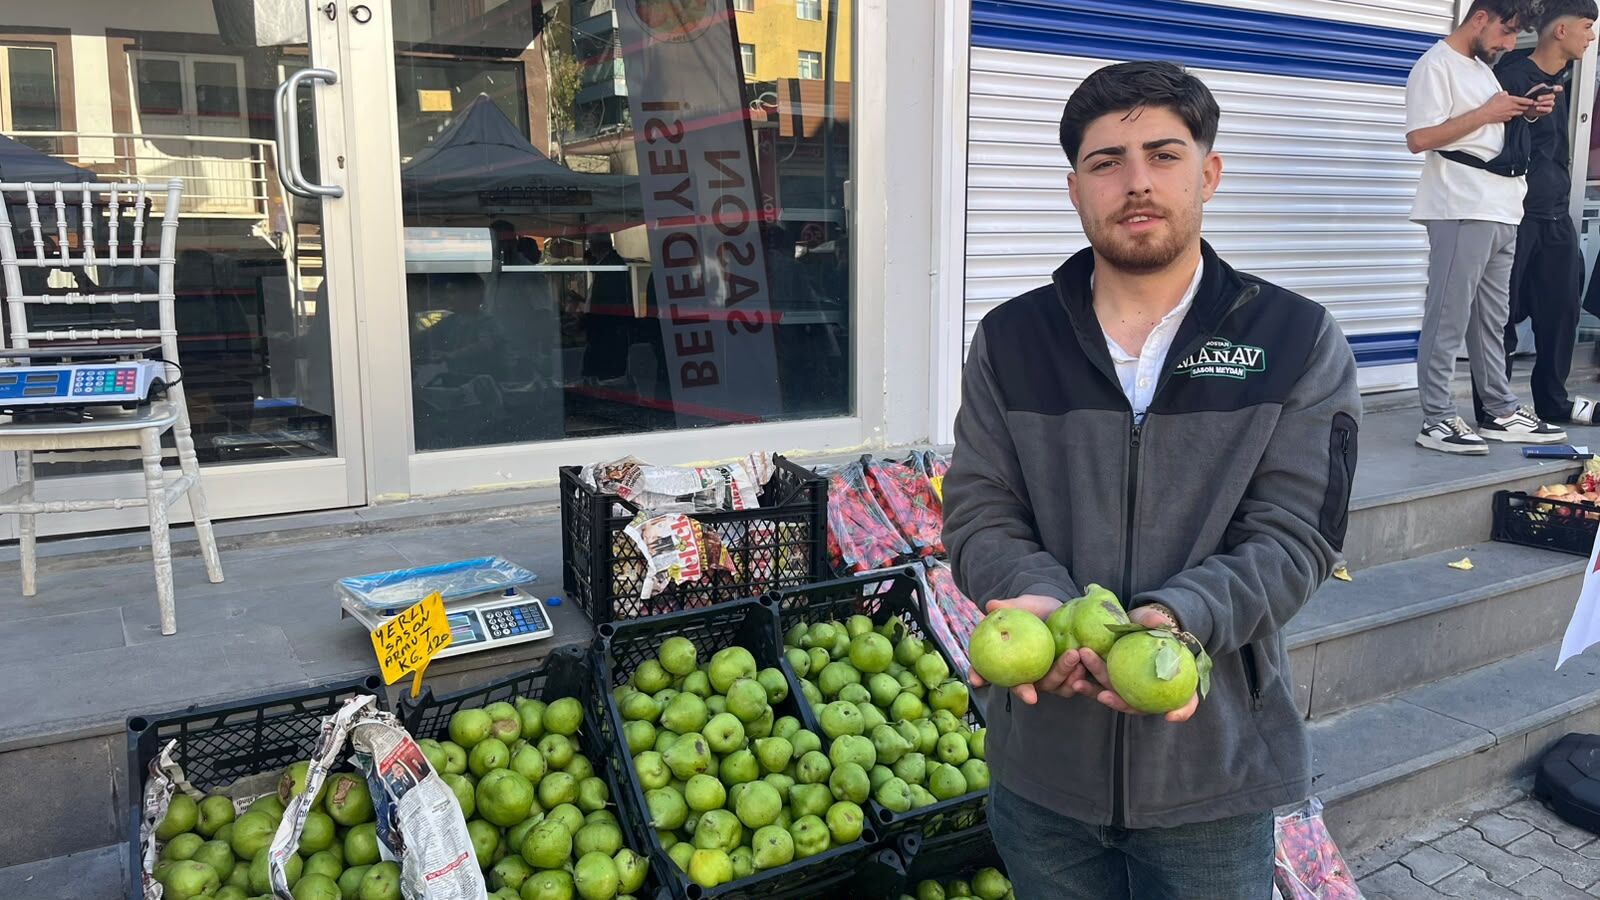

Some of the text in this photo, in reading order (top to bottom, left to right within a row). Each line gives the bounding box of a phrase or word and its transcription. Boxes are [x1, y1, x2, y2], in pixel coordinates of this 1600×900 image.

[1177, 347, 1262, 369] MANAV
[1192, 366, 1214, 375] SASON
[385, 626, 432, 667] ARMUT
[386, 610, 430, 654] SASON
